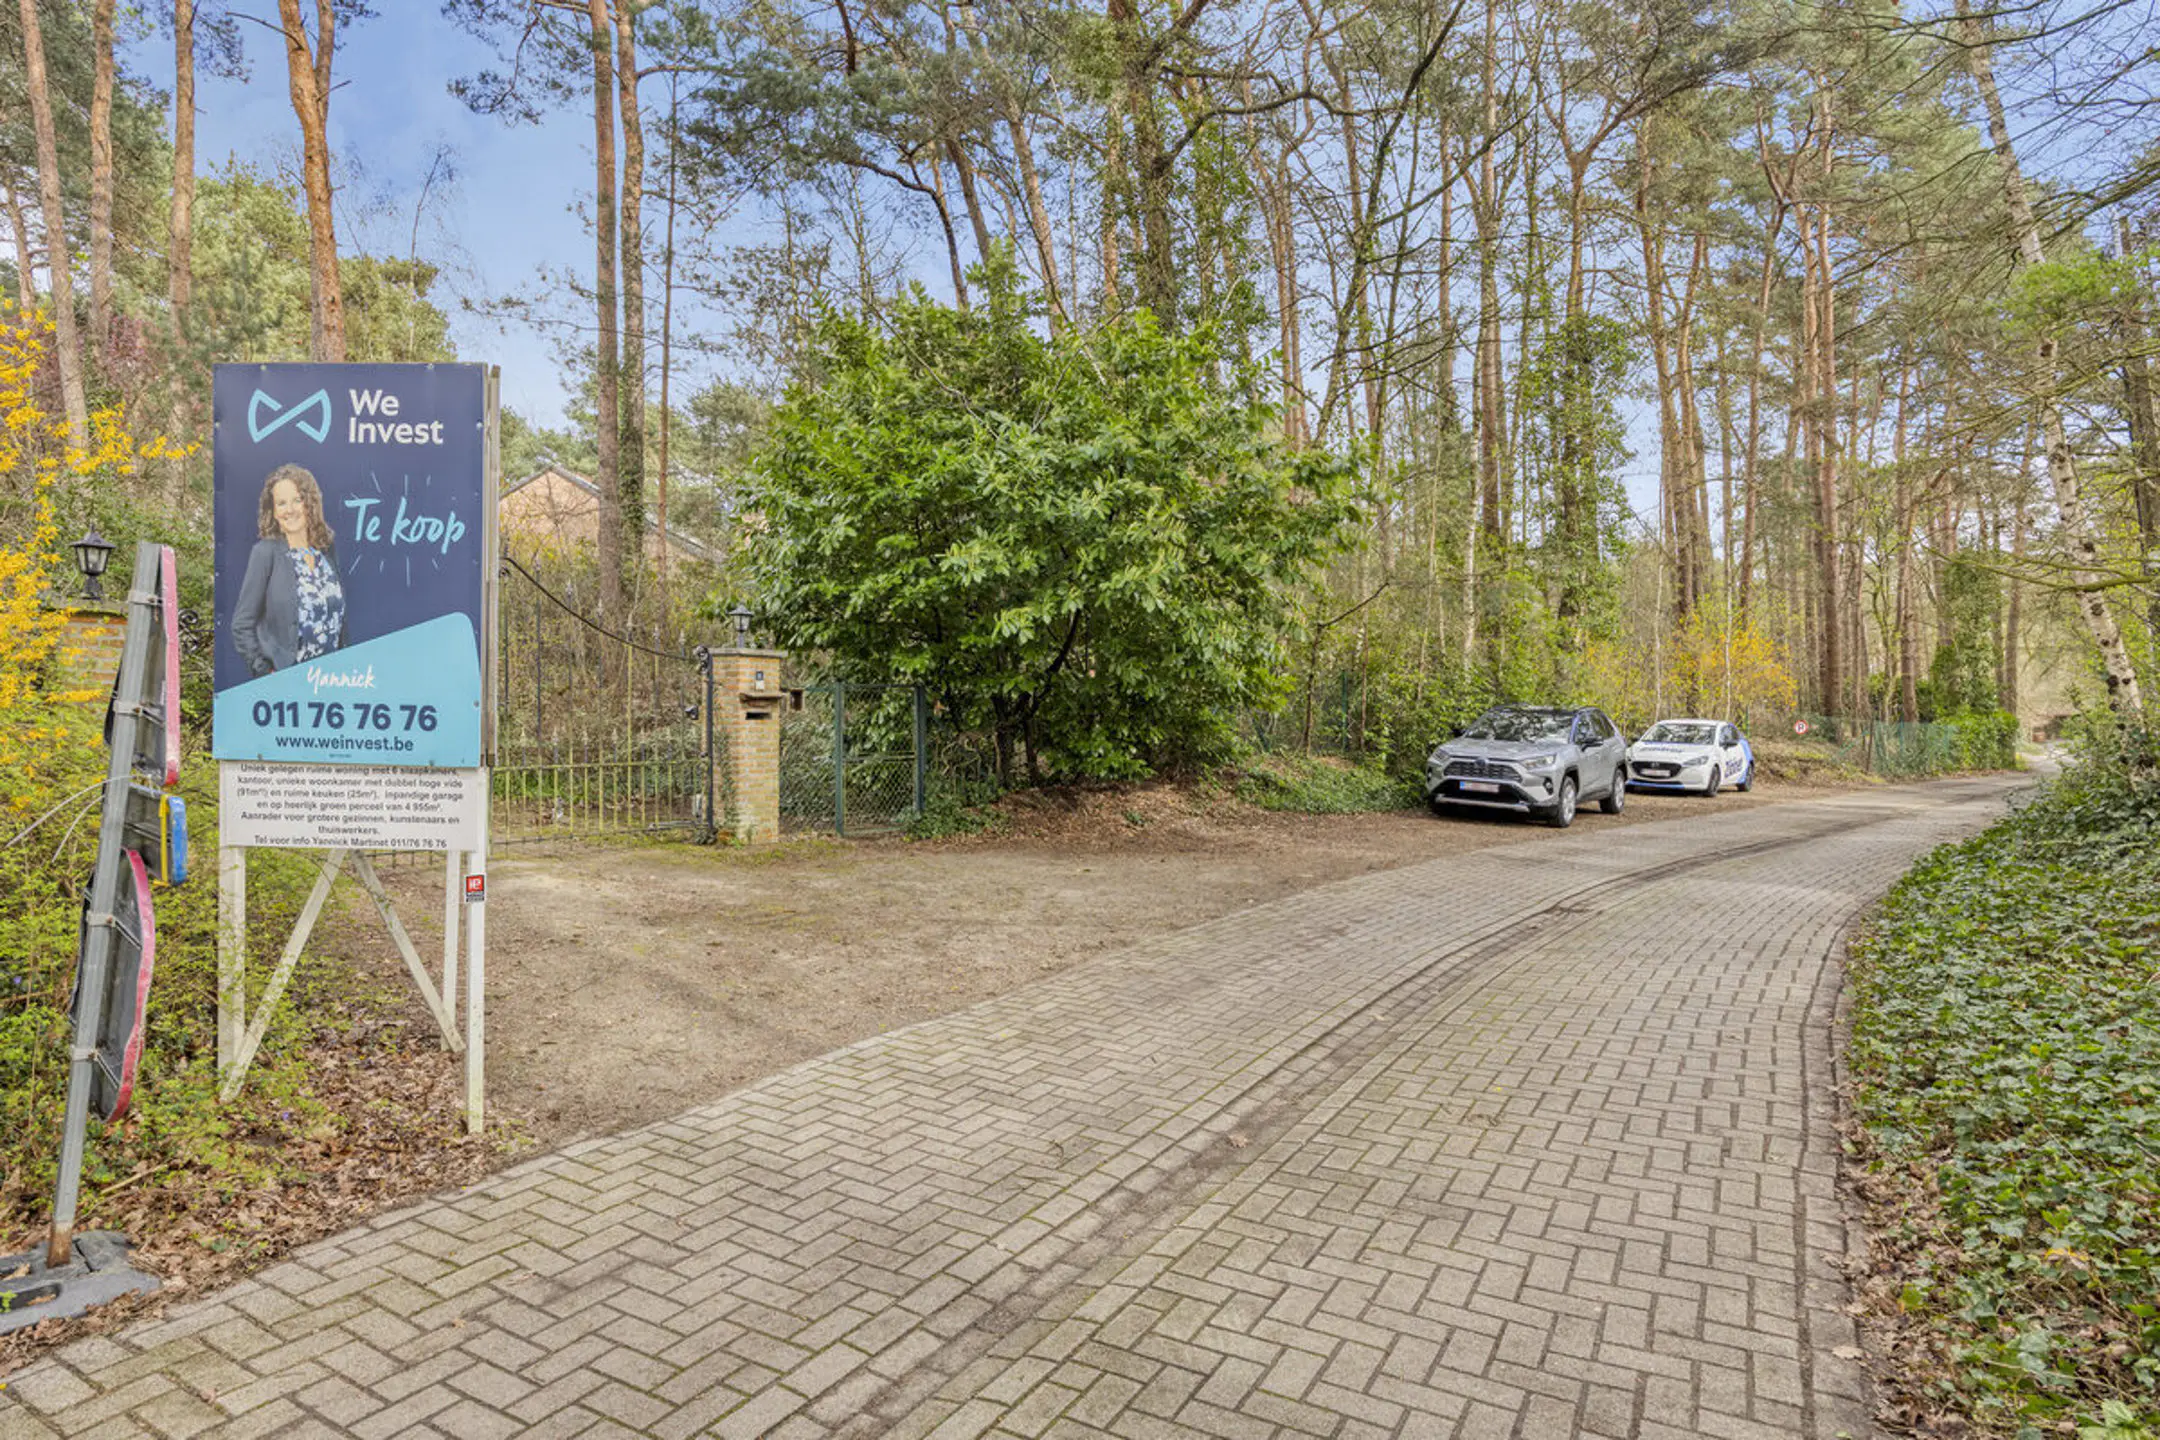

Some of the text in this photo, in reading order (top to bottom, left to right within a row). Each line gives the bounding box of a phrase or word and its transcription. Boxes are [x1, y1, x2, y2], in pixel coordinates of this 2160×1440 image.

[348, 388, 398, 415] We
[348, 419, 443, 445] Invest
[345, 498, 465, 555] Te koop
[307, 664, 376, 694] Yannick
[253, 700, 437, 732] 011 76 76 76
[276, 735, 413, 751] www.weinvest.be
[241, 764, 265, 772] Uniek
[269, 764, 304, 774] gelegen
[335, 766, 369, 776] woning
[237, 776, 273, 784] kantoor,
[276, 777, 305, 785] unieke
[309, 776, 361, 786] woonkamer
[419, 779, 440, 788] hoge
[444, 780, 462, 788] vide
[284, 789, 310, 797] ruime
[385, 791, 430, 800] Inpandige
[432, 793, 463, 801] garage
[270, 802, 282, 810] op
[284, 801, 316, 811] heerlijk
[320, 802, 346, 811] groen
[349, 803, 384, 811] perceel
[241, 811, 281, 820] Aanrader
[307, 814, 340, 822] grotere
[342, 814, 387, 823] gezinnen,
[390, 815, 446, 824] kunstenaars
[318, 825, 380, 834] thuiswerkers.
[254, 835, 267, 844] Tel
[291, 836, 310, 844] info
[312, 837, 348, 845] Yannick
[351, 838, 388, 847] Martinet
[390, 839, 420, 847] 011/76
[422, 839, 433, 847] 76
[435, 839, 447, 848] 76
